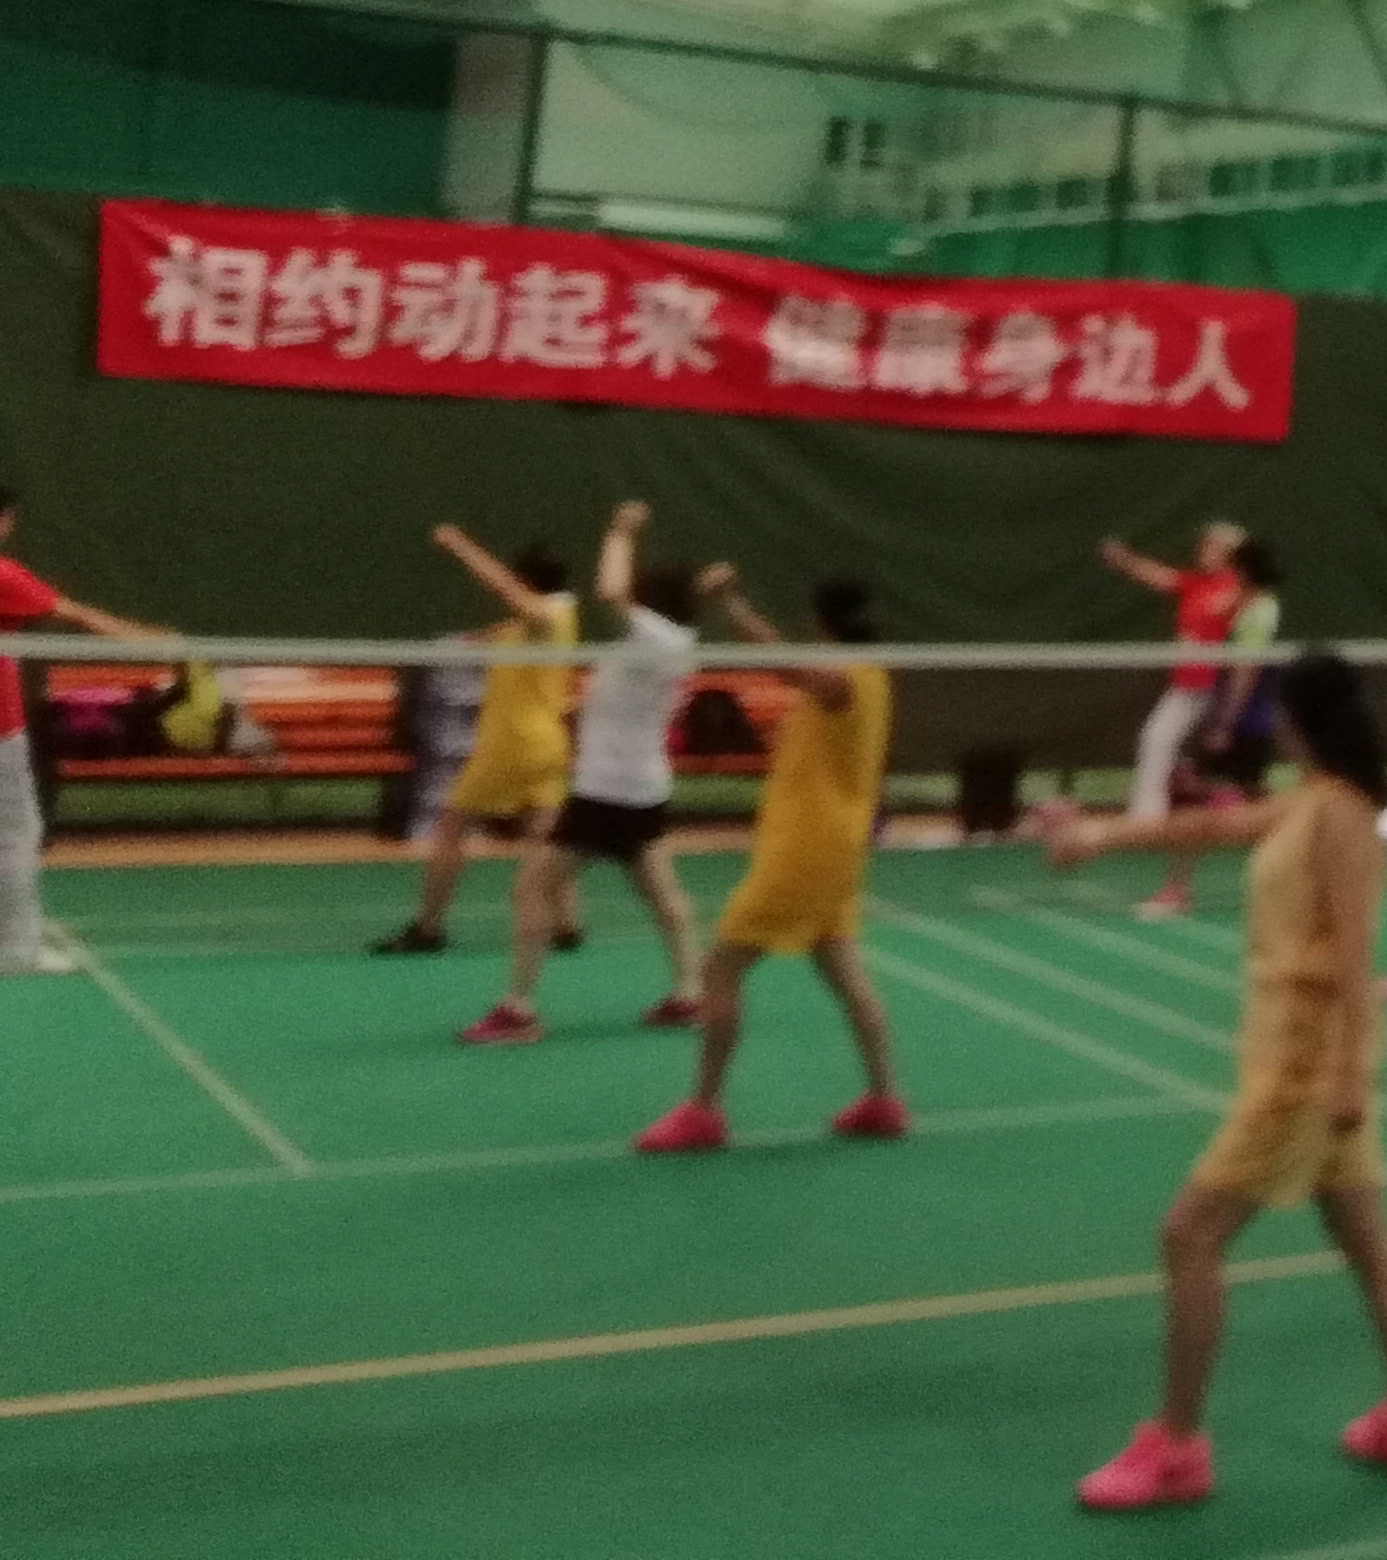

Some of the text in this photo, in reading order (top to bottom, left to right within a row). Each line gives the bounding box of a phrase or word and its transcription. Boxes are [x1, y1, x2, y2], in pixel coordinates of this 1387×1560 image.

[145, 234, 721, 378] 相约动起来
